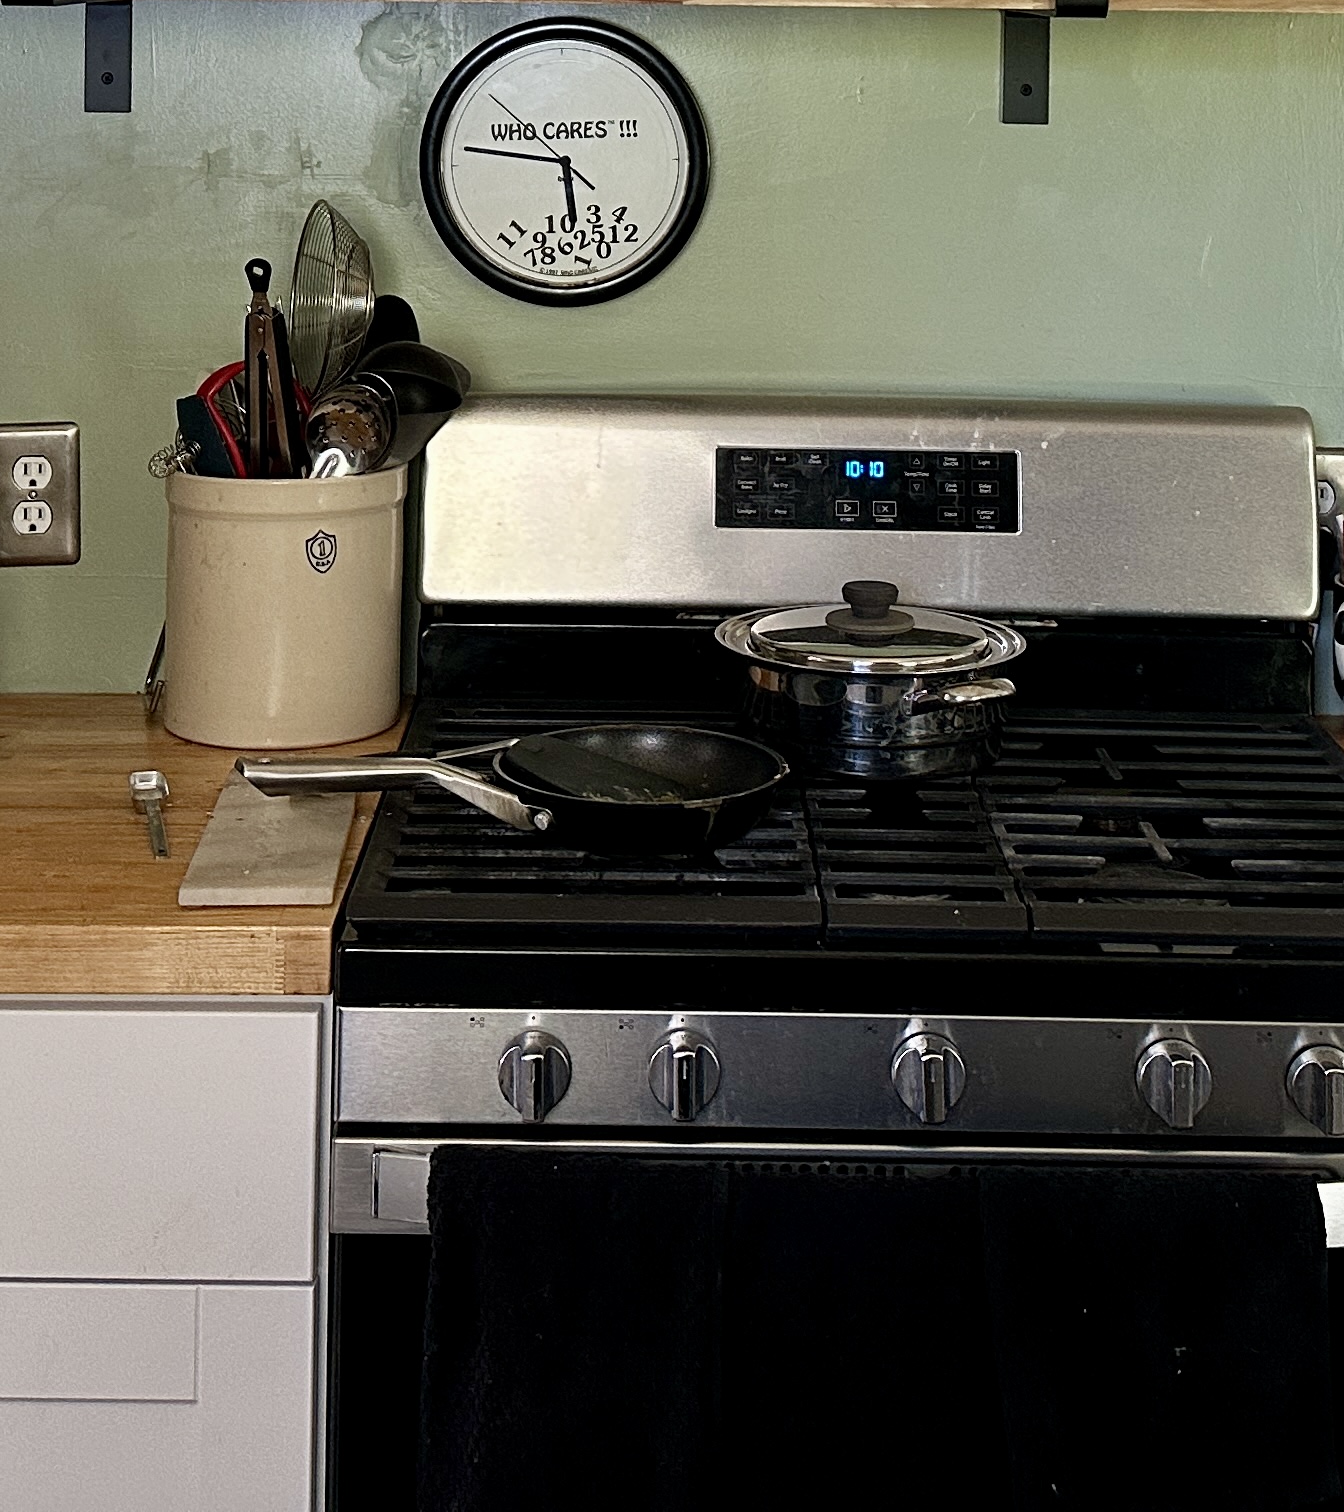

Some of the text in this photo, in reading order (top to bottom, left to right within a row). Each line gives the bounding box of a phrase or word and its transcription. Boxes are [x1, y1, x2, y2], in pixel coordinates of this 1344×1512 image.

[491, 122, 537, 141] WHO
[587, 204, 601, 224] 3
[612, 206, 628, 224] 4
[545, 214, 576, 234] 10
[497, 220, 528, 249] 11
[532, 232, 547, 250] 9
[558, 236, 573, 255] 6
[846, 461, 884, 478] 10:10
